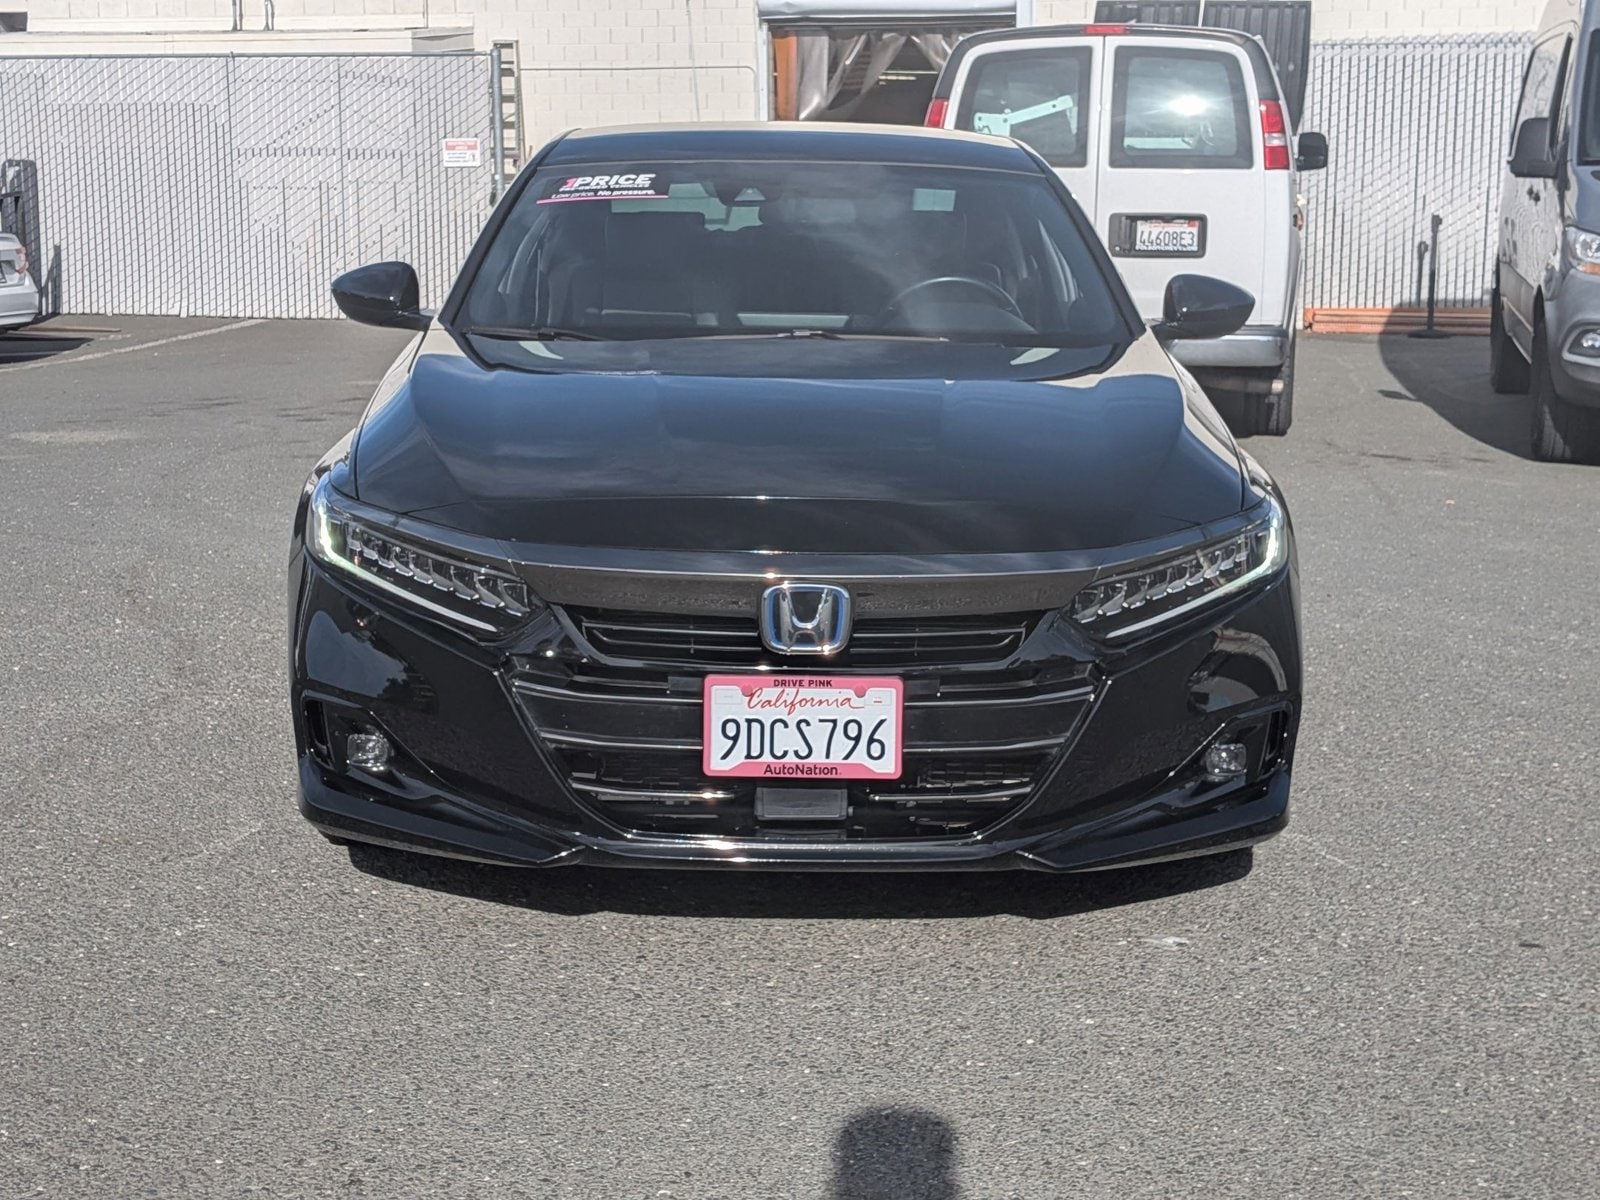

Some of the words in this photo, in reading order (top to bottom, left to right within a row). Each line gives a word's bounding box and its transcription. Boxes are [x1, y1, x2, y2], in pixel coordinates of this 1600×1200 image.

[1139, 230, 1195, 247] 44608E3
[773, 679, 805, 688] DRIVE
[808, 679, 833, 688] PINK
[747, 687, 864, 716] California
[719, 717, 888, 761] 9DCS796
